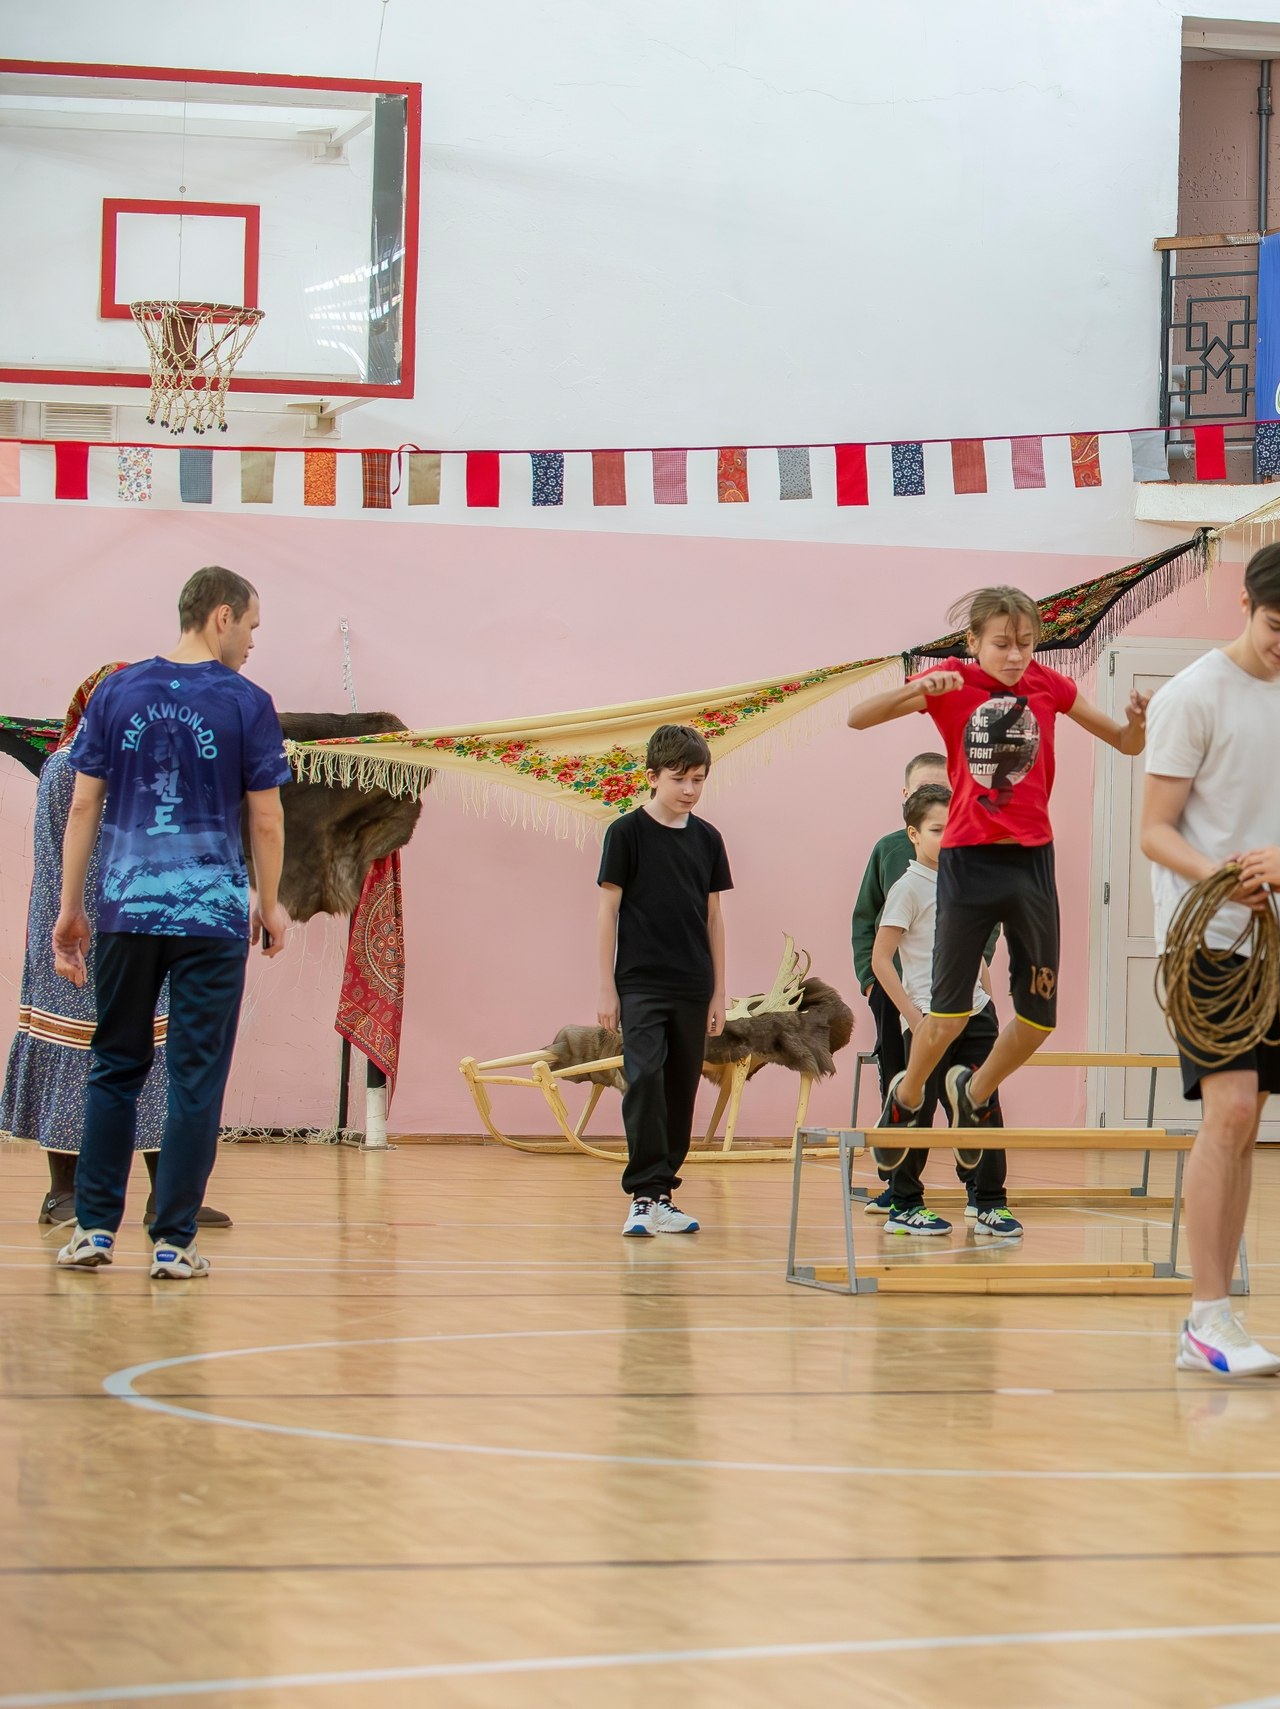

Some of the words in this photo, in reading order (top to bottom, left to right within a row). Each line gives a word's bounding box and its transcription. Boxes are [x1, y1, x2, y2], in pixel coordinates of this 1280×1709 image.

[971, 716, 989, 727] ONE
[121, 712, 147, 751] TAE
[146, 702, 218, 760] KWON-DO
[970, 731, 989, 743] TWO
[969, 748, 994, 759] FIGHT
